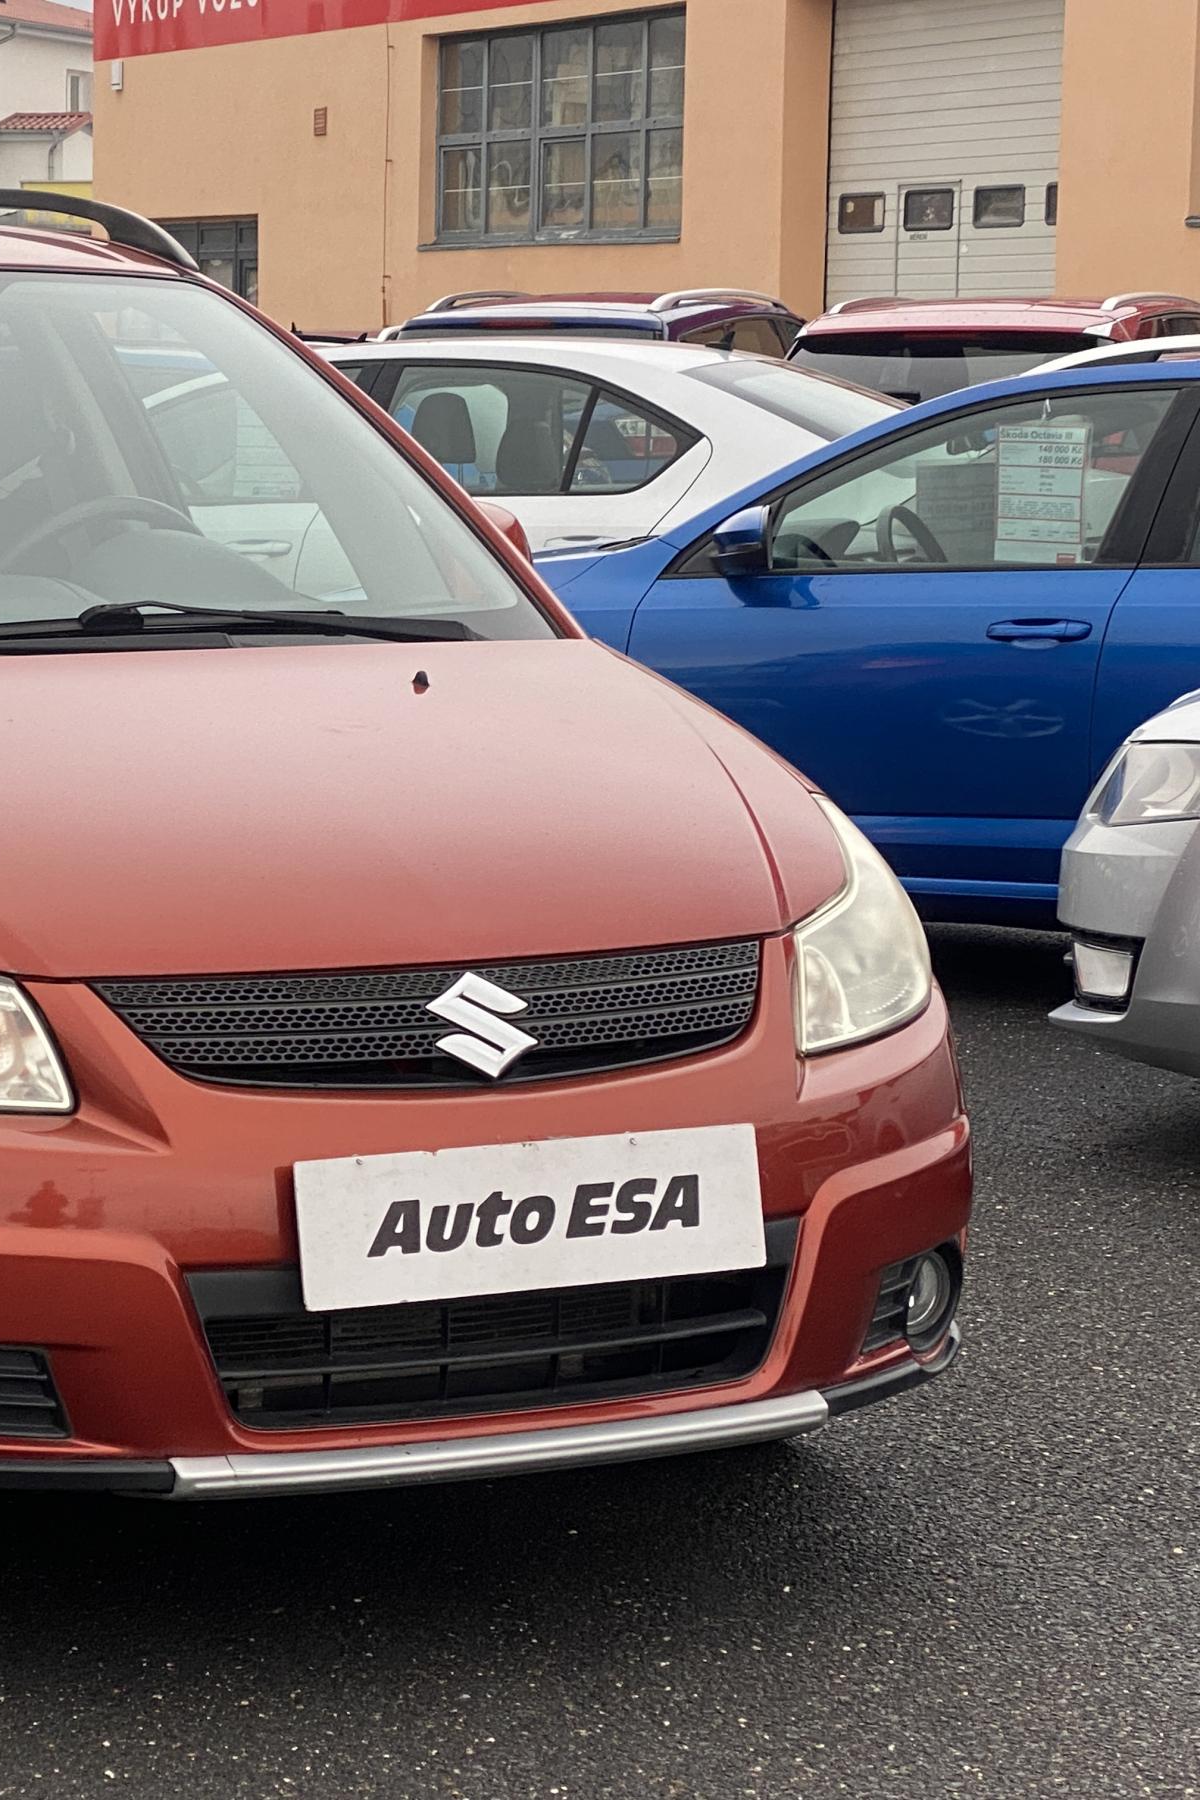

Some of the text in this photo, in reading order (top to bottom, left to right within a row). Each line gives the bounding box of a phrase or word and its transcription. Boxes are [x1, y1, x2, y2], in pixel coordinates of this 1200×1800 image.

[112, 0, 258, 27] VYKUP VO
[1030, 430, 1063, 440] Octavia
[367, 1174, 701, 1259] Auto ESA
